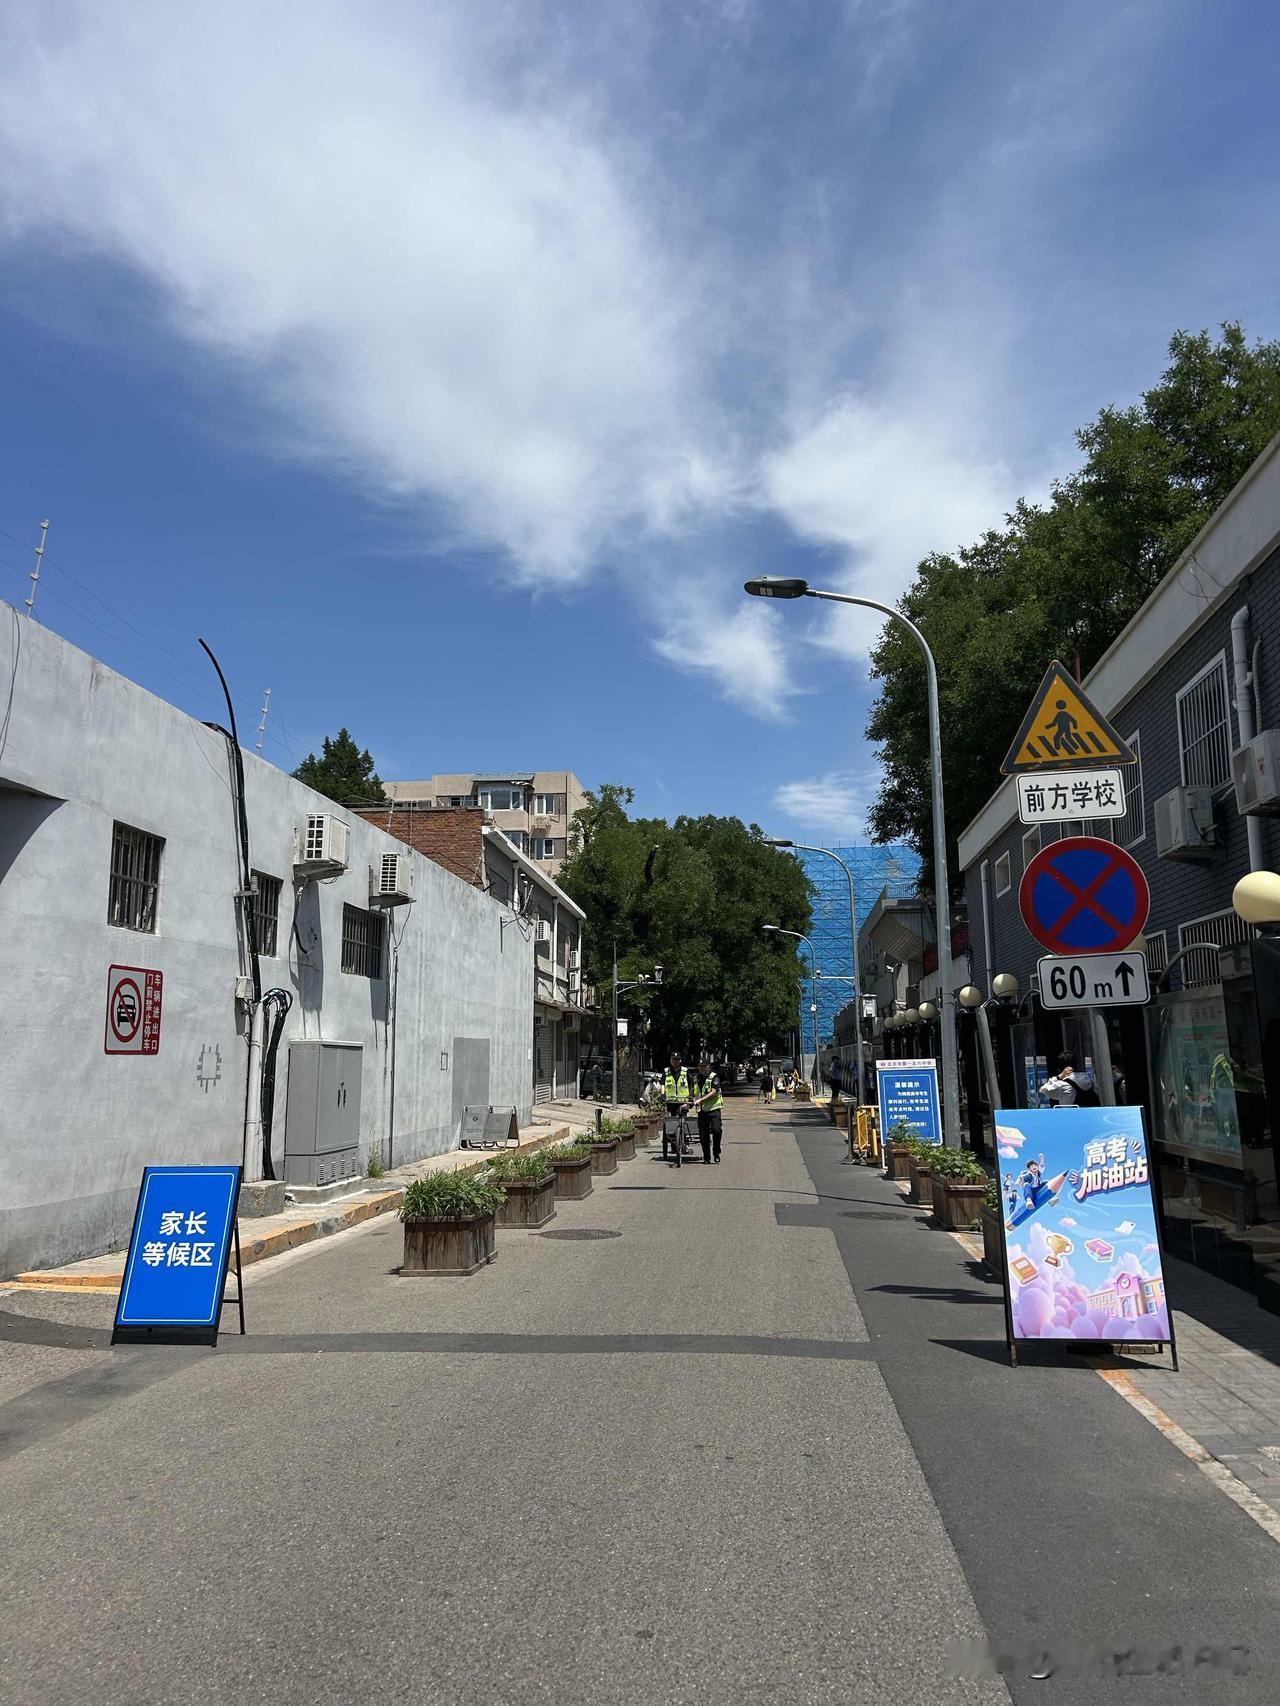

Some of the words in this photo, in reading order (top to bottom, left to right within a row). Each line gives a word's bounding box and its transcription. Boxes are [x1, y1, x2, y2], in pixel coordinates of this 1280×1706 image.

[1024, 779, 1118, 813] 前方学校
[143, 973, 154, 1051] 门前禁止停车
[151, 974, 161, 1050] 车辆进出口
[1086, 1136, 1128, 1168] 高考
[1075, 1156, 1148, 1200] 加油站
[159, 1210, 208, 1237] 家长
[141, 1241, 216, 1268] 等候区
